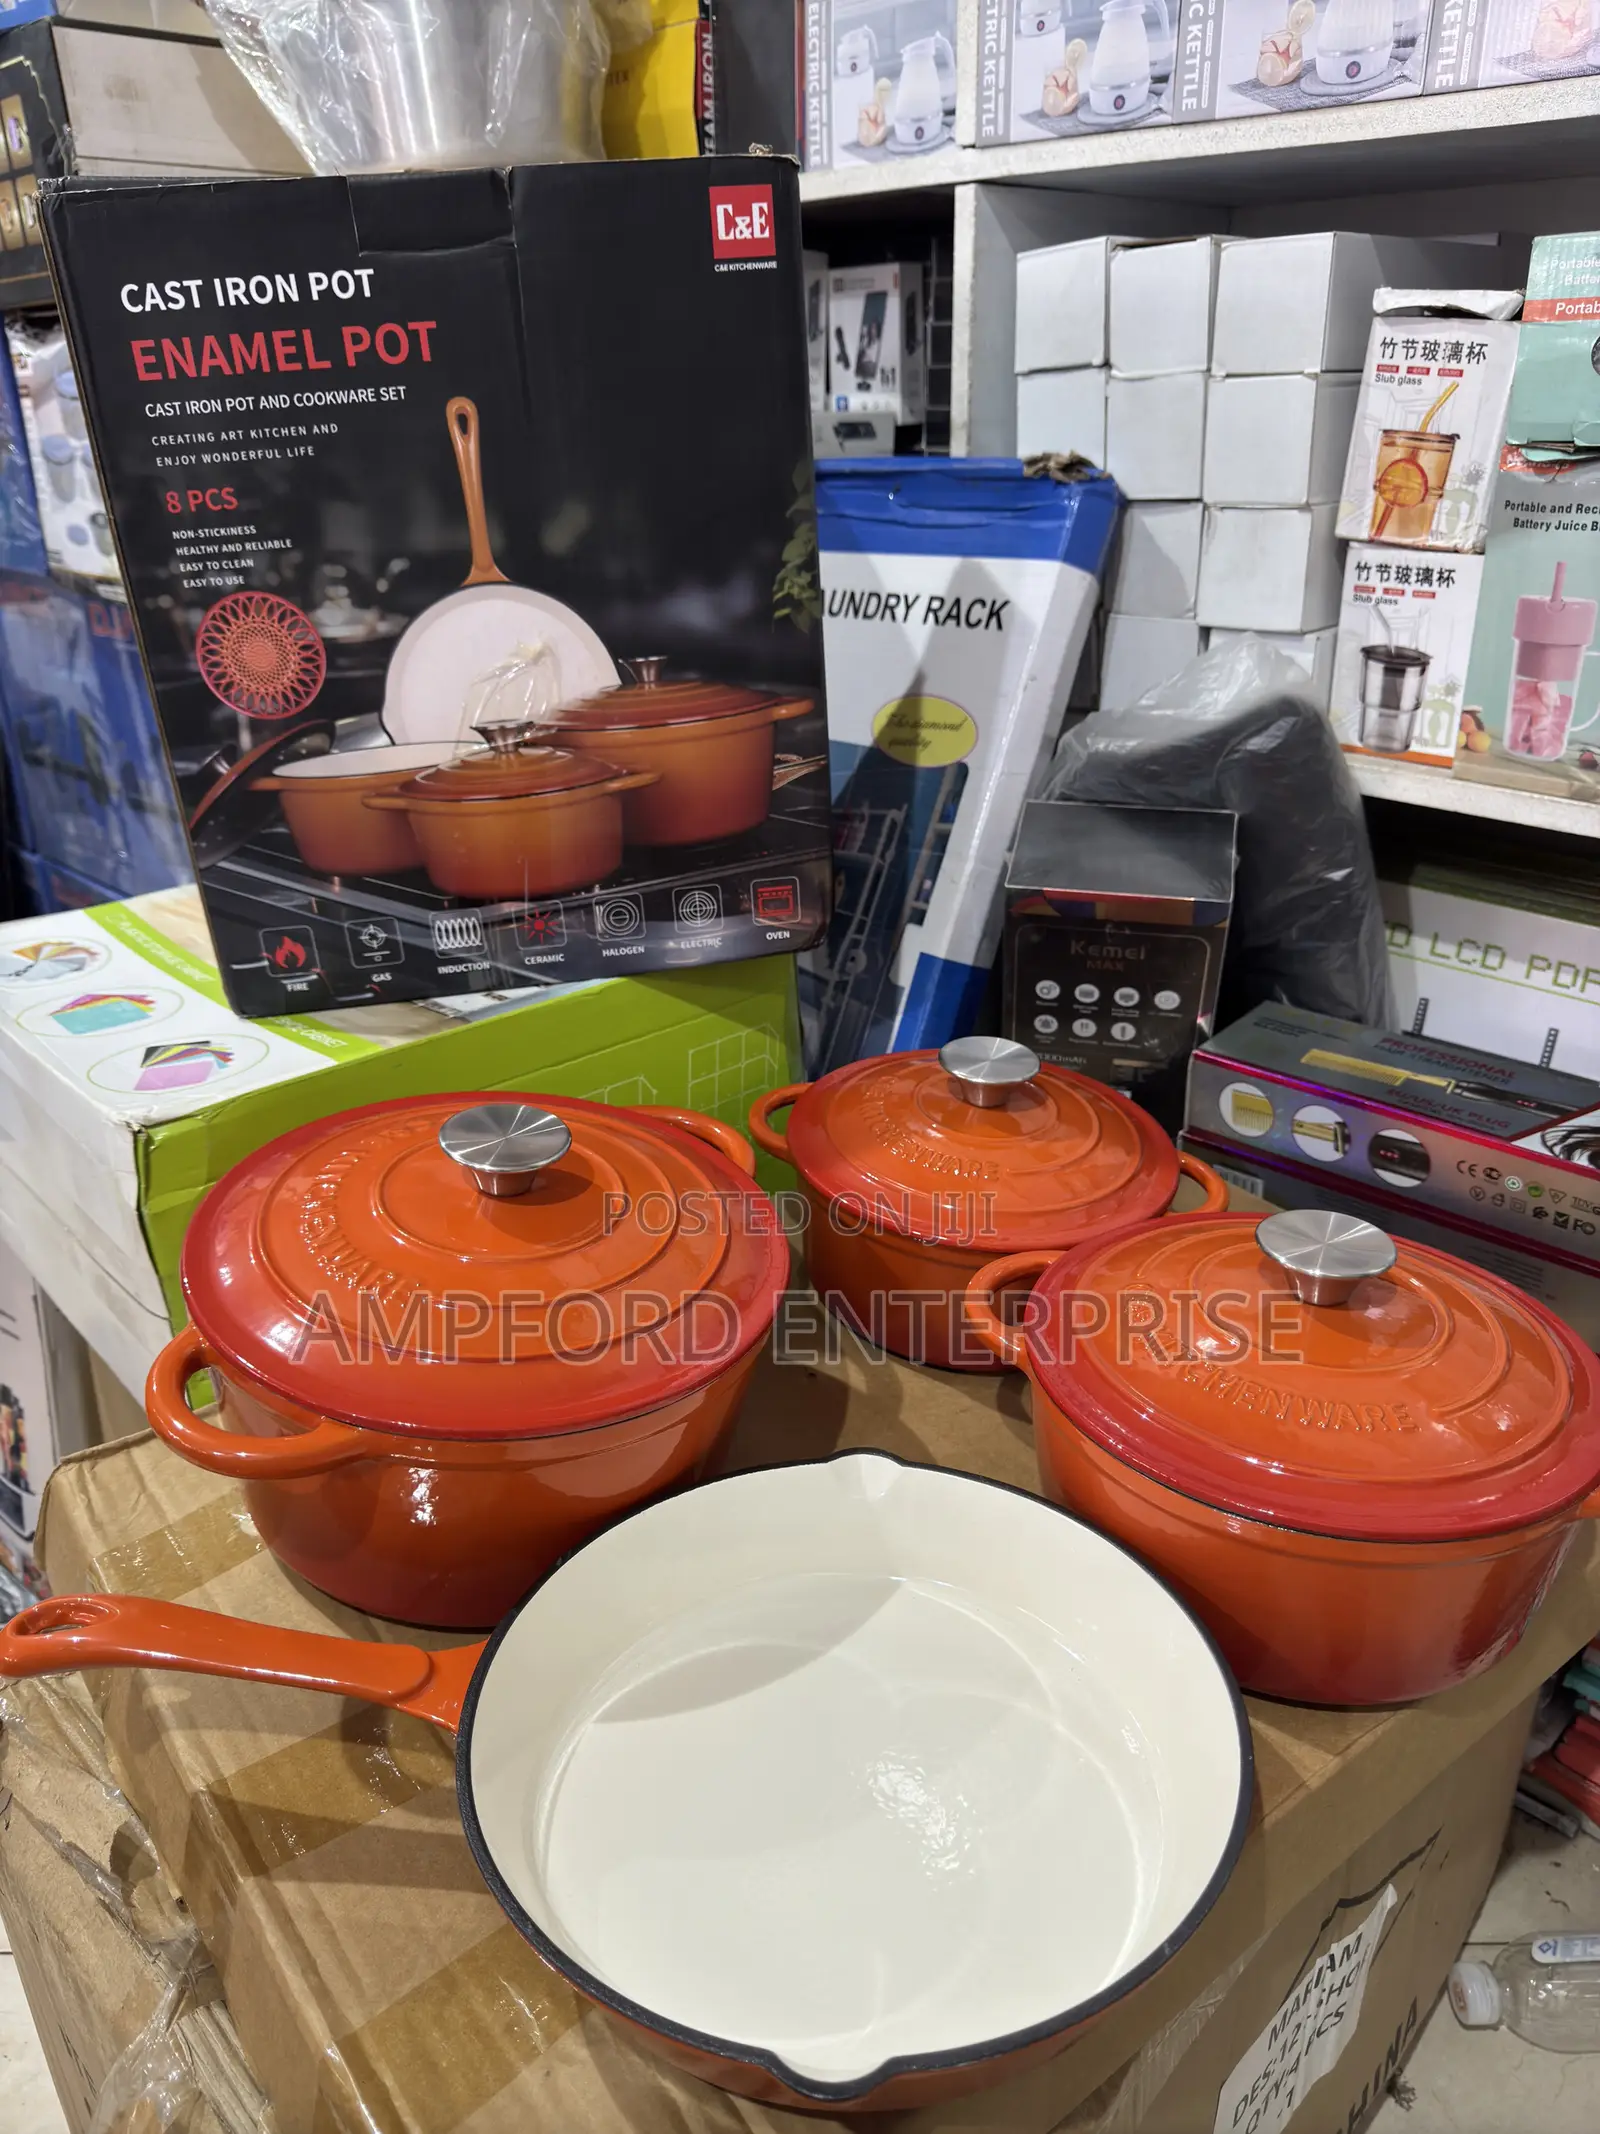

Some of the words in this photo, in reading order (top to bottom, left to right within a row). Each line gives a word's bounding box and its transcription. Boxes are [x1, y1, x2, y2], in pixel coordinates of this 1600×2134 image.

[808, 2, 820, 93] ELECTRIC
[982, 59, 996, 138] KETTLE
[808, 98, 821, 167] KETTLE
[716, 201, 770, 241] C&E
[729, 260, 778, 271] KITCHENWARE
[121, 279, 203, 313] CAST
[213, 273, 300, 307] IRON
[308, 268, 375, 301] POT
[130, 328, 333, 382] ENAMEL
[342, 320, 437, 368] POT
[1380, 336, 1489, 365] 竹节玻璃杯
[1374, 373, 1396, 384] Slub
[1397, 374, 1423, 387] glass
[145, 401, 182, 418] CAST
[185, 397, 223, 416] IRON
[225, 396, 255, 413] POT
[259, 393, 290, 410] AND
[293, 388, 377, 408] COOKWARE
[379, 385, 407, 401] SET
[151, 431, 216, 447] CREATING
[220, 429, 245, 442] ART
[250, 425, 308, 440] KITCHEN
[312, 423, 339, 435] AND
[156, 454, 197, 467] ENJOY
[201, 448, 282, 465] WONDERFUL
[286, 445, 316, 458] LIFE
[165, 490, 182, 514] 8
[186, 486, 239, 513] PCS
[1504, 499, 1547, 514] Portable
[1549, 502, 1573, 514] and
[1575, 503, 1600, 514] Rec
[172, 525, 257, 540] NON-STICKINESS
[1513, 517, 1552, 532] Battery
[1554, 520, 1588, 532] Juice
[175, 544, 219, 557] HEALTHY
[221, 542, 243, 553] AND
[244, 538, 292, 552] RELIABLE
[179, 561, 204, 573] EASY
[206, 560, 220, 571] TO
[222, 558, 255, 570] CLEAN
[1354, 561, 1457, 589] 竹节玻璃杯
[183, 578, 208, 589] EASY
[209, 576, 224, 587] TO
[225, 575, 245, 586] USE
[1374, 595, 1399, 606] glass
[922, 595, 1011, 631] RACK
[680, 937, 723, 949] ELECTRIC
[766, 929, 791, 941] OVEN
[524, 953, 565, 966] CERAMIC
[602, 945, 645, 958] HALOGEN
[1429, 931, 1507, 972] LCD
[371, 972, 393, 983] GAS
[437, 961, 491, 975] INDUCTION
[286, 981, 310, 992] FIRE
[1336, 1995, 1418, 2134] HINA
